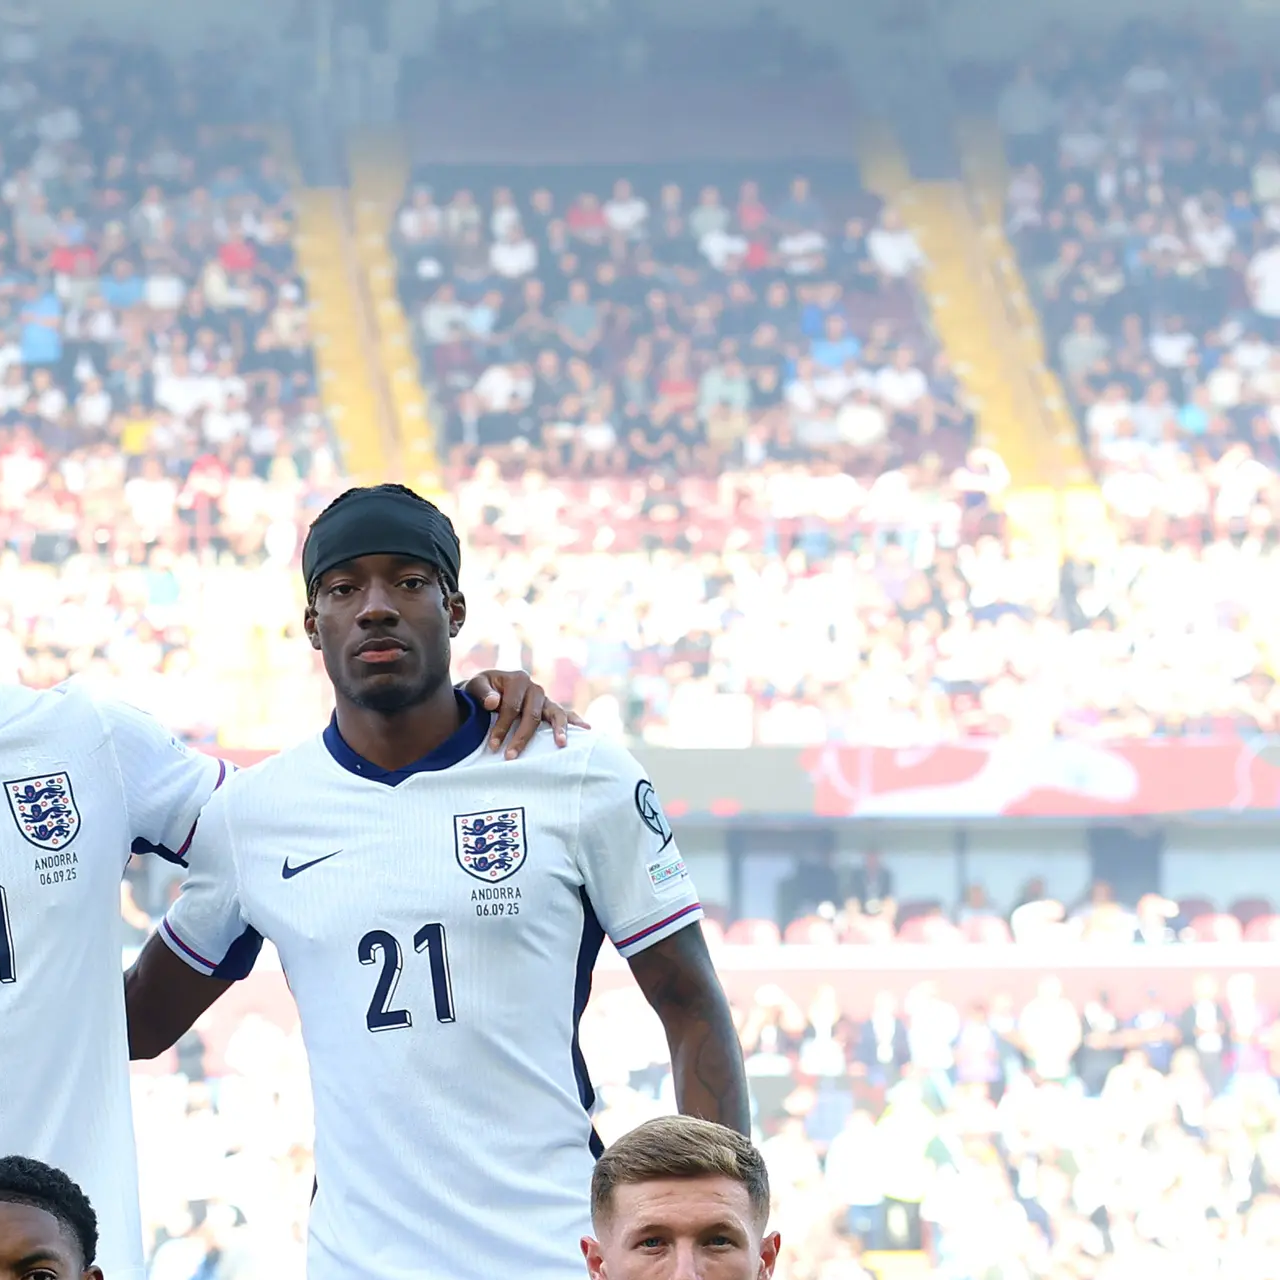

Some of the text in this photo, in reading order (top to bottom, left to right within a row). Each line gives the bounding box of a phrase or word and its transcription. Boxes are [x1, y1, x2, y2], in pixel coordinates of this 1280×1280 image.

[34, 851, 79, 871] ANDORRA
[40, 867, 77, 885] 06.09.25
[471, 886, 522, 901] ANDORRA
[476, 902, 520, 916] 06.09.25
[358, 923, 456, 1032] 21
